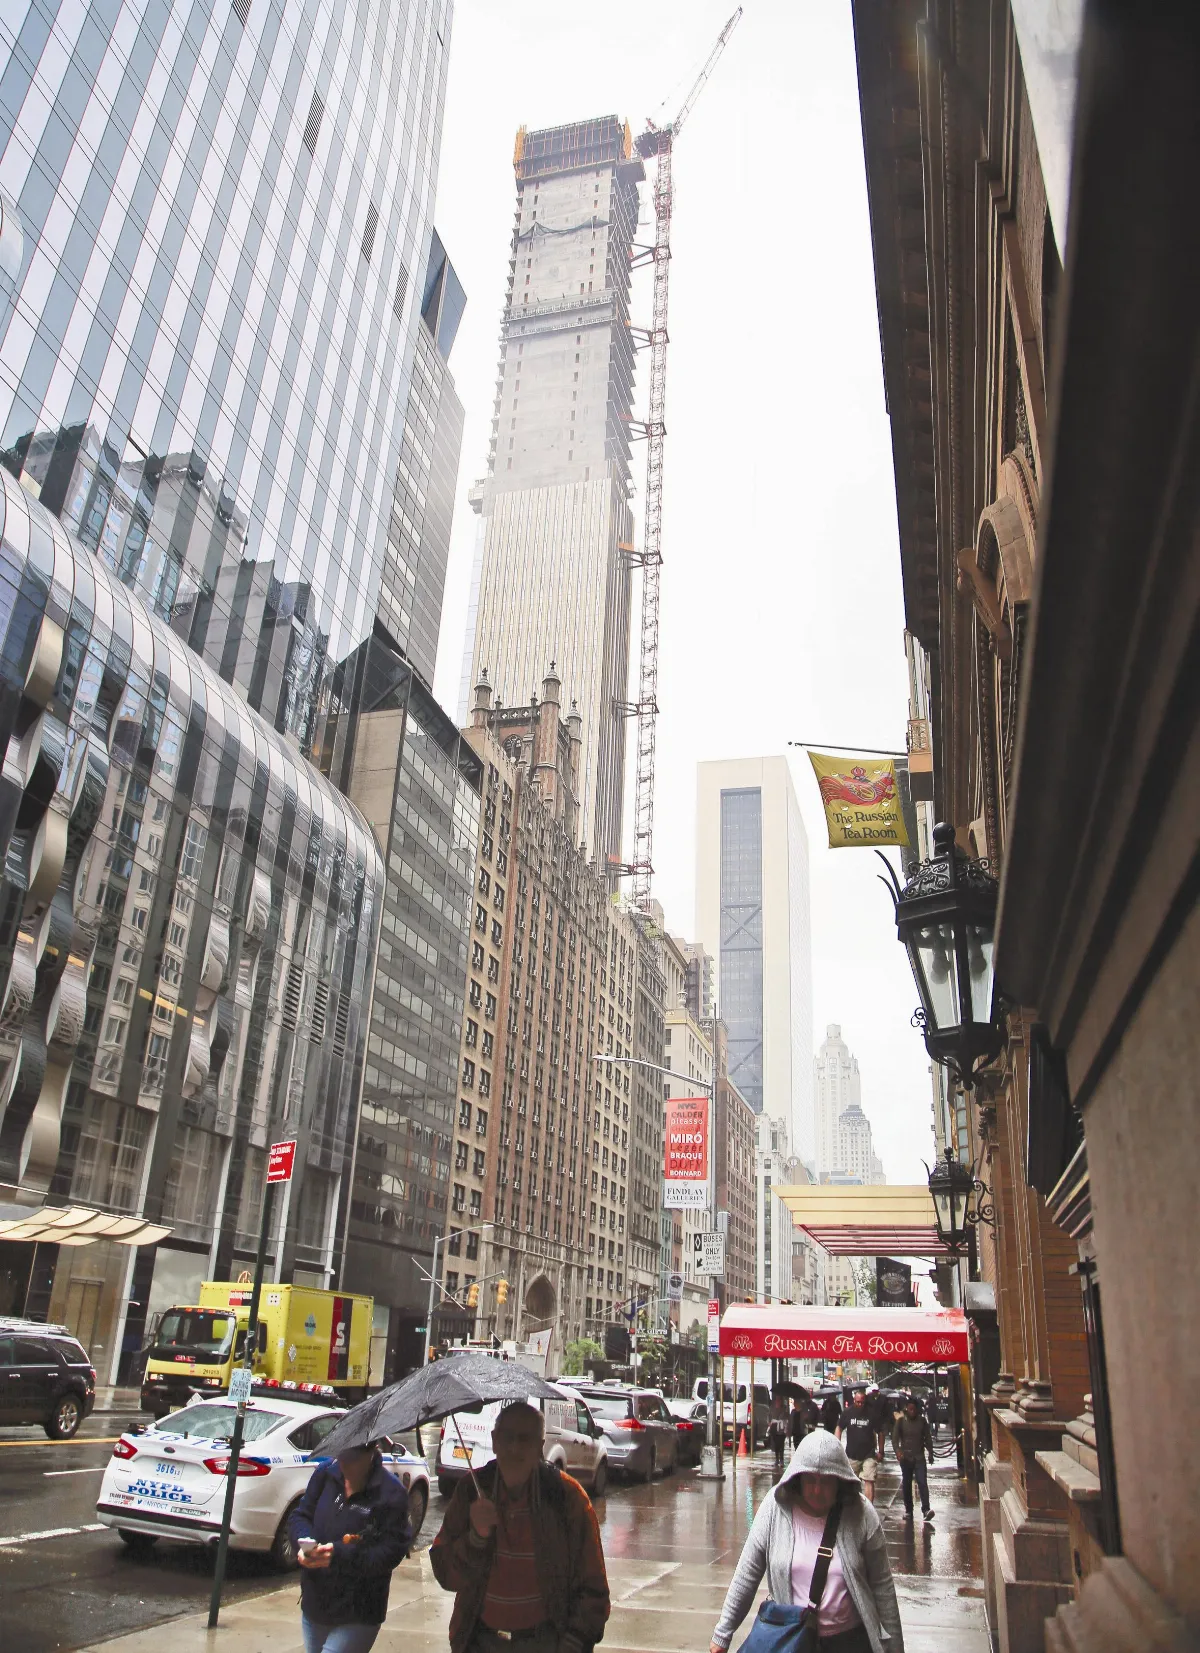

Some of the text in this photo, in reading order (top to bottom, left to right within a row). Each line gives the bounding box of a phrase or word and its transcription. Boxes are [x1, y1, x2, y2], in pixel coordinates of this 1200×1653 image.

[833, 811, 898, 824] The Russian
[841, 827, 898, 839] Tea Room
[671, 1111, 703, 1119] CALDER
[671, 1118, 703, 1126] picasso
[670, 1131, 703, 1144] MIRÓ
[670, 1152, 703, 1160] BRAQUE
[670, 1160, 703, 1169] DUFY
[705, 1247, 720, 1255] ONLY
[764, 1334, 918, 1354] RUSSIAN TEA ROOM
[155, 1462, 176, 1475] 3616
[135, 1478, 185, 1492] NYPD
[127, 1485, 193, 1504] POLICE
